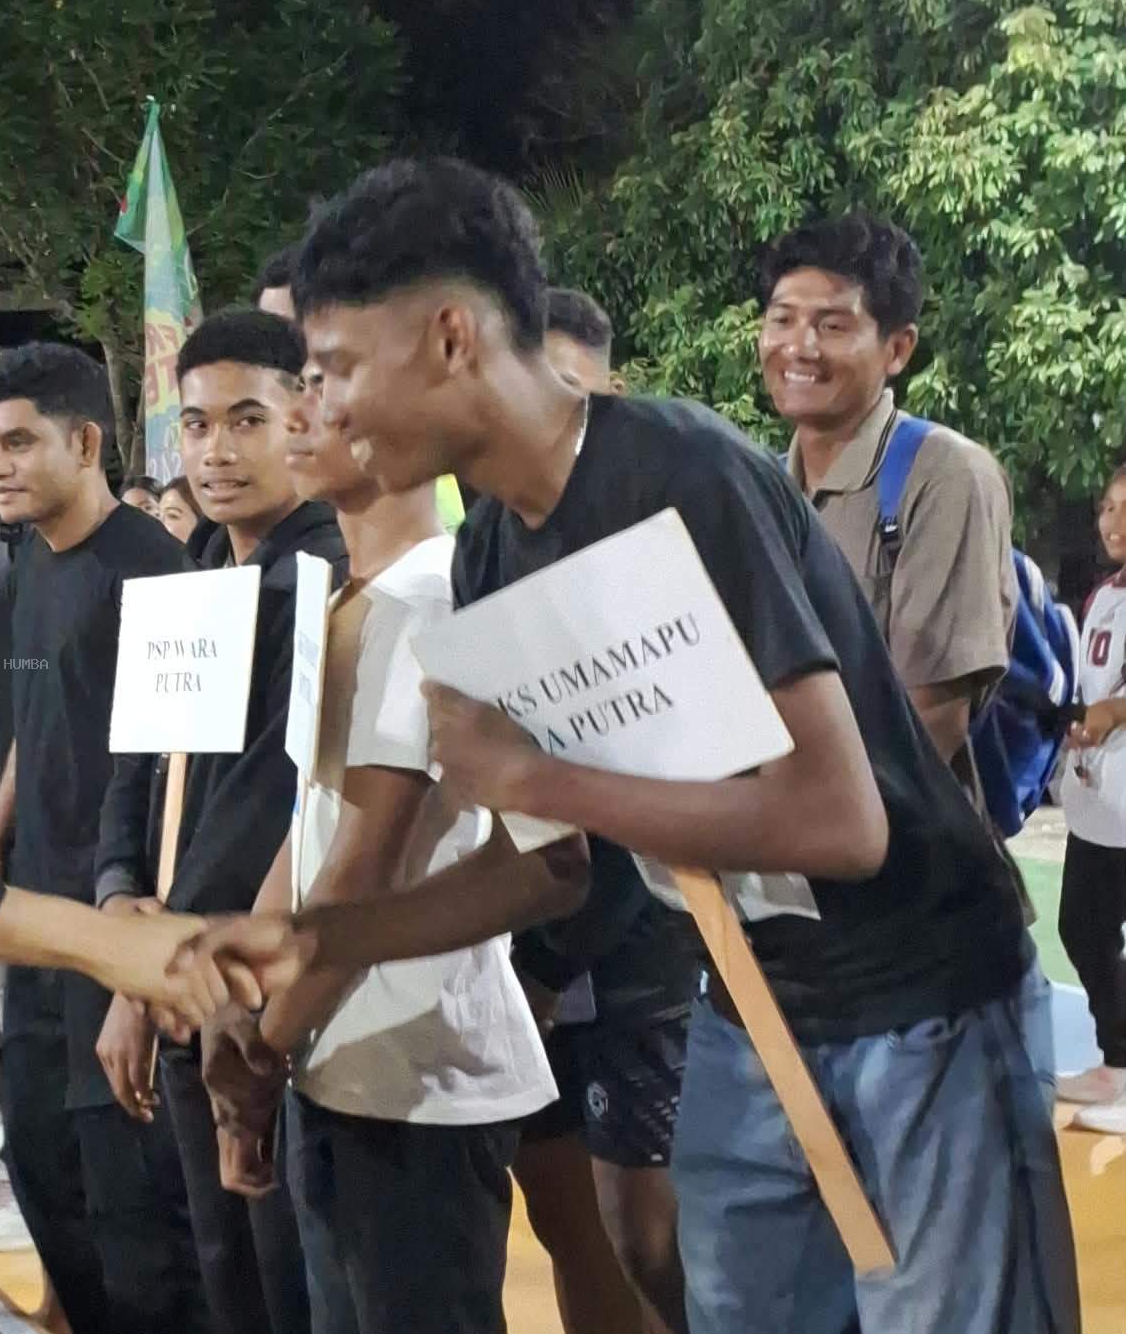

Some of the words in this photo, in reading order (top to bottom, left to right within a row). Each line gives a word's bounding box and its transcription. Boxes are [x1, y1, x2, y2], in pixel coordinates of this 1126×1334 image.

[155, 671, 202, 693] PUTRA
[538, 612, 701, 705] UMAMAPU
[569, 682, 674, 743] PUTRA
